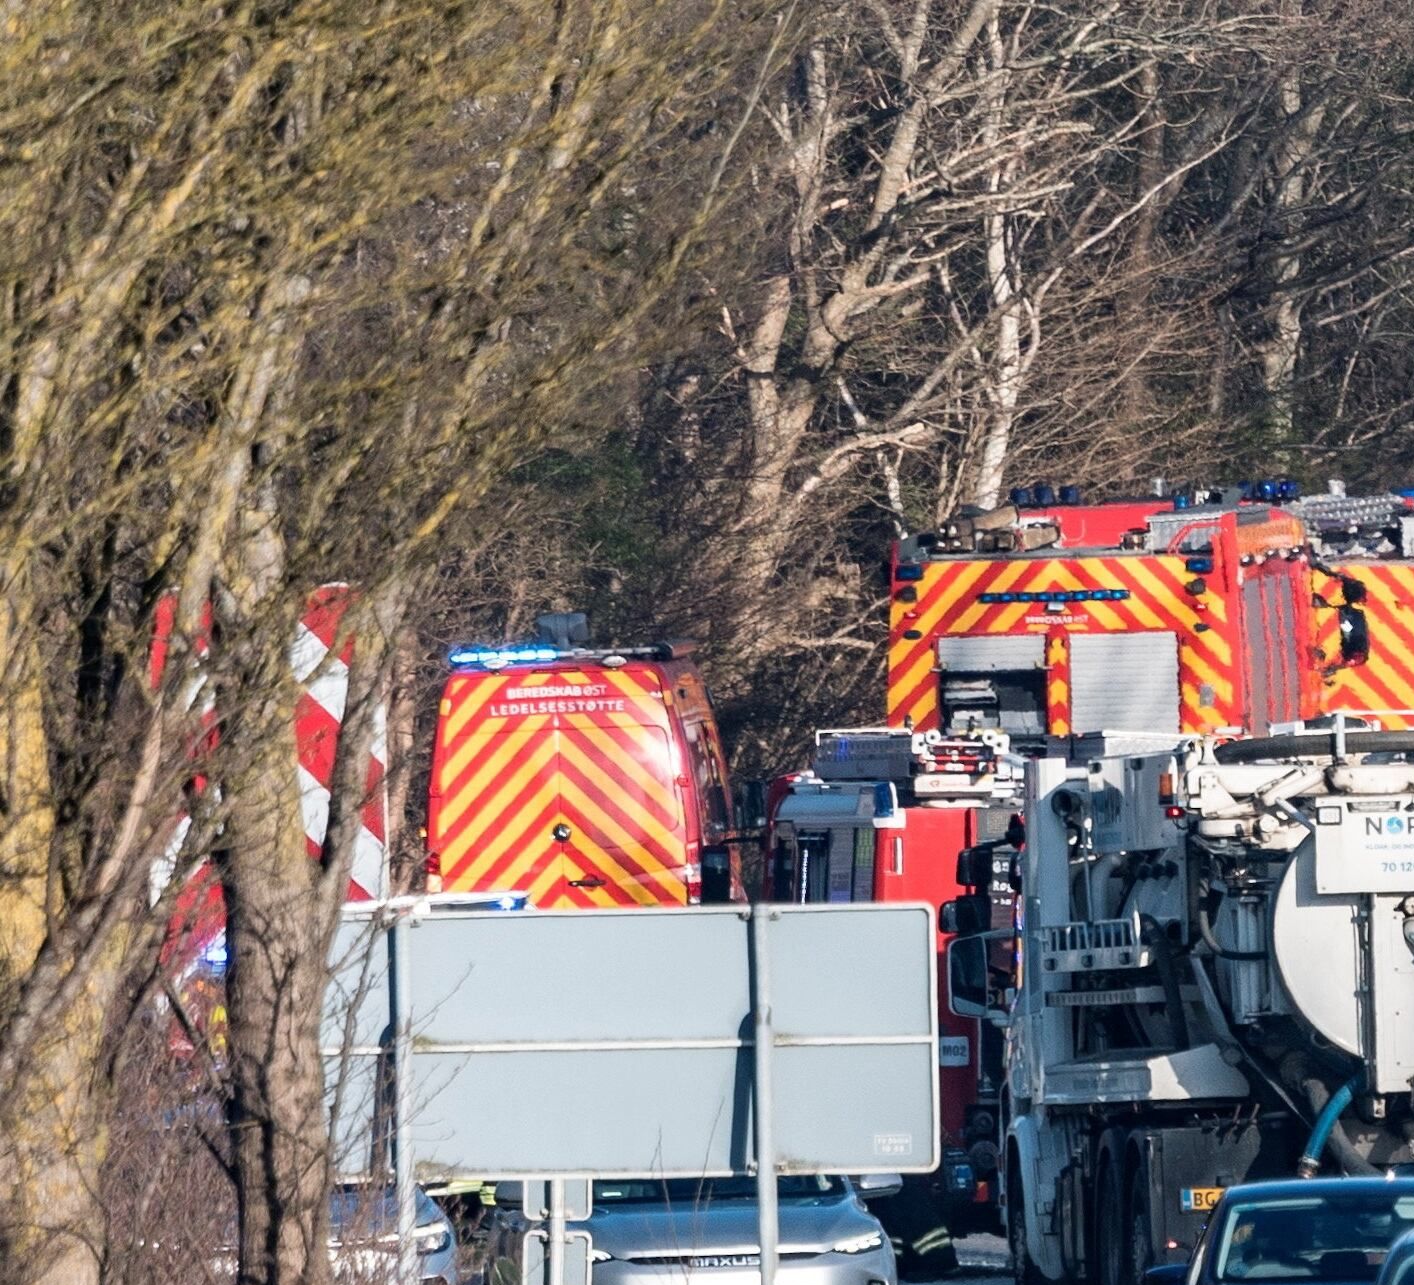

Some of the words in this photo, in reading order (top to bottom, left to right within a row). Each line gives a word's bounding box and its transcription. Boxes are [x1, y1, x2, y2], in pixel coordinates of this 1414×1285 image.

[506, 685, 583, 700] BEREDSKAB
[583, 684, 607, 697] ØST
[490, 700, 625, 717] LEDELSESSTØTTE
[1381, 861, 1398, 873] 70
[690, 1255, 760, 1267] MAXUS
